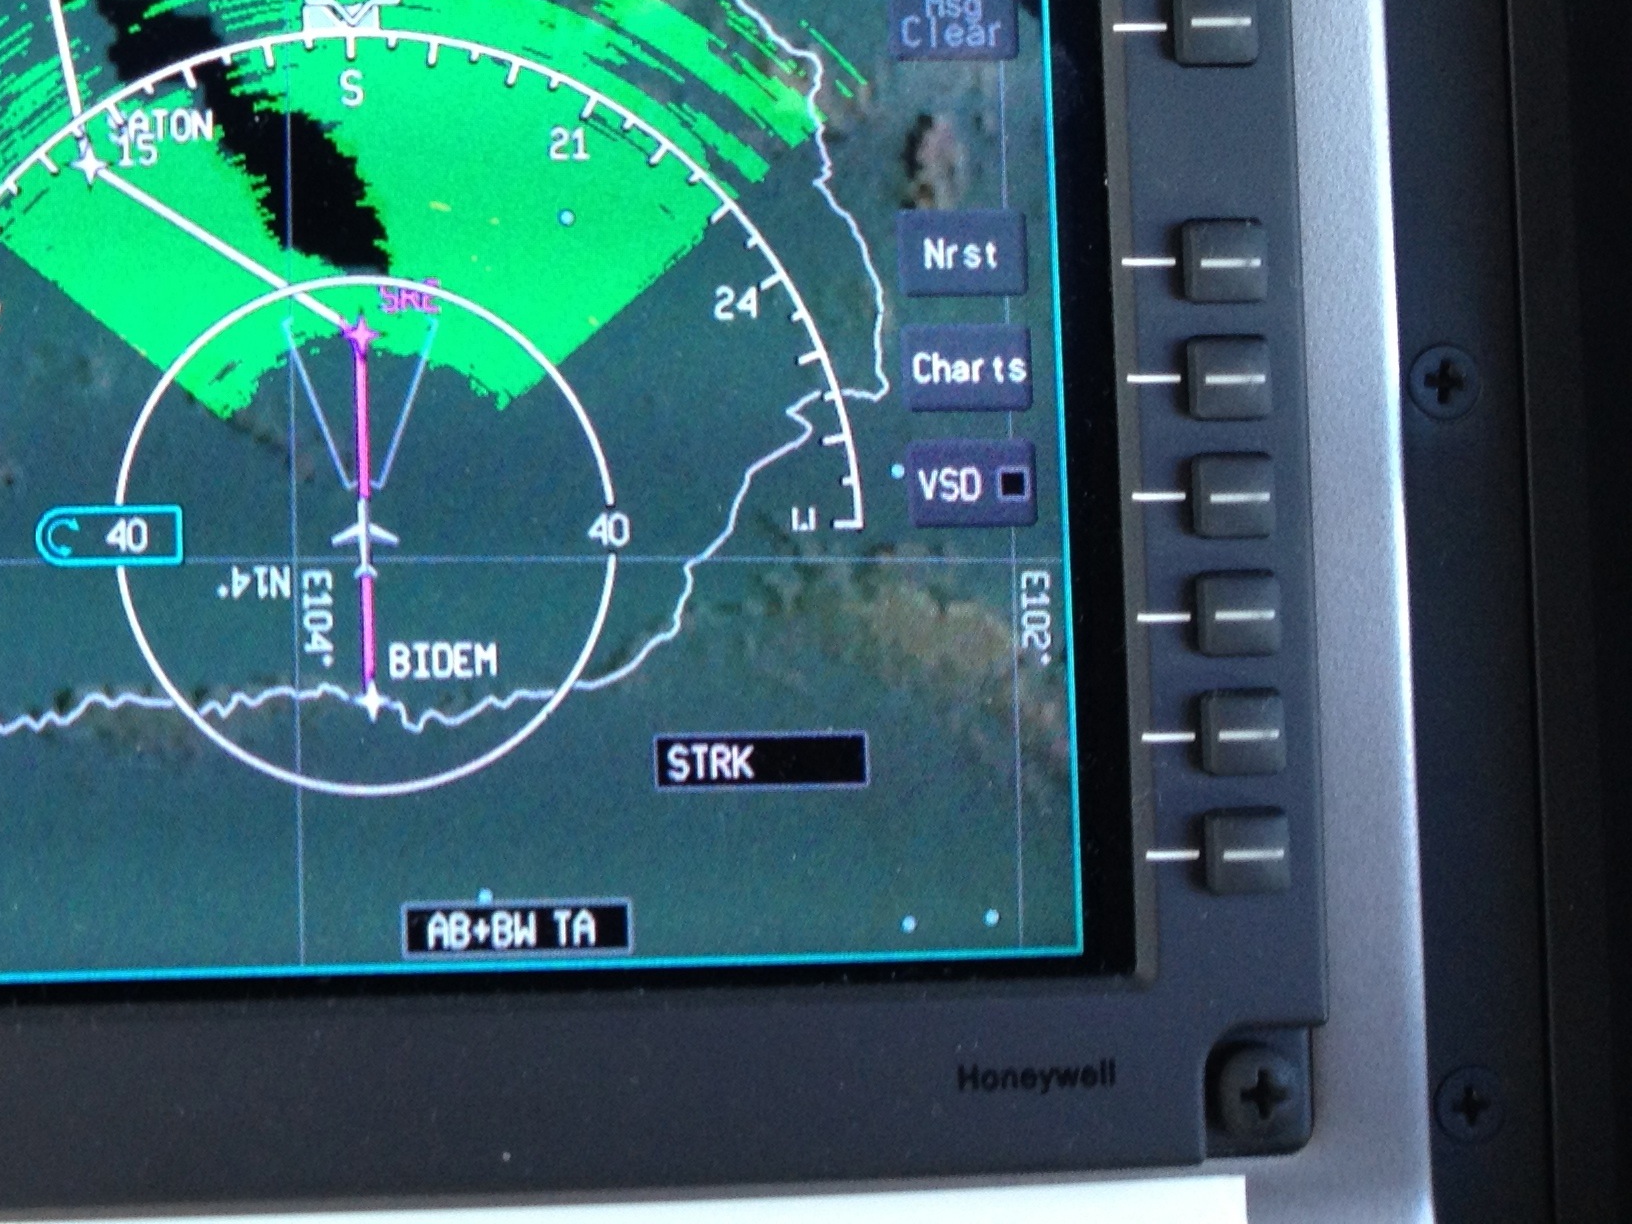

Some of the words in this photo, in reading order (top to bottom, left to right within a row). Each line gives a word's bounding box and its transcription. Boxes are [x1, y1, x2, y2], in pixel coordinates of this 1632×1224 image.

[901, 18, 1002, 47] Clear
[340, 69, 365, 107] S
[118, 133, 158, 167] 15
[549, 129, 590, 161] 21
[924, 240, 998, 269] Nrst
[714, 287, 758, 321] 24
[912, 355, 1027, 385] Charts
[918, 470, 982, 502] VSD
[106, 518, 149, 552] 40
[588, 514, 630, 546] 40
[389, 644, 499, 677] BIDEM
[668, 745, 756, 782] STRK
[427, 911, 536, 947] AB+BW
[554, 910, 597, 945] TA
[957, 1057, 1116, 1094] Honeywell
